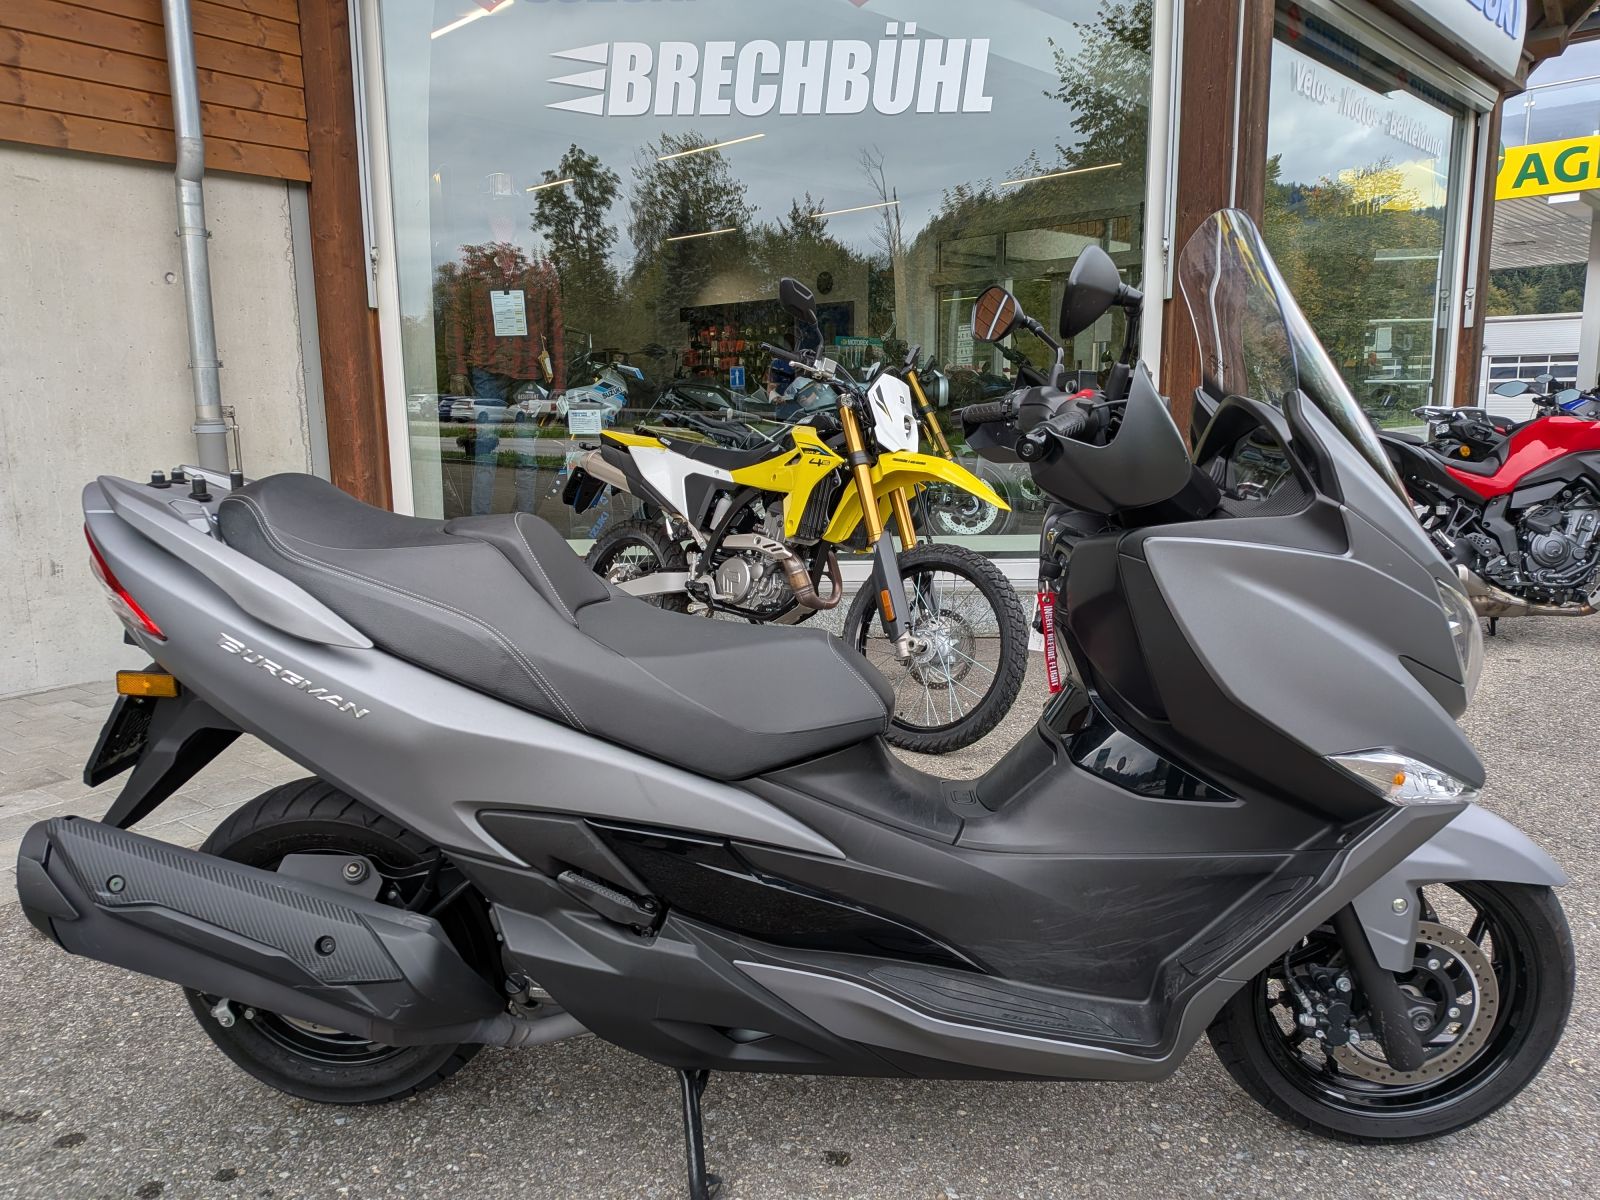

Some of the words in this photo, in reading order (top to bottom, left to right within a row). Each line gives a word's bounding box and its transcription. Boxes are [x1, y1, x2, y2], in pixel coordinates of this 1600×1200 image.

[607, 22, 994, 117] BRECHBÜHL
[1296, 60, 1330, 103] Velos
[1343, 86, 1379, 128] Motos
[1389, 110, 1443, 159] Bekleidung
[1043, 605, 1055, 632] INSERT
[1046, 633, 1056, 661] BEFORE
[215, 632, 371, 719] BURGMAN
[1048, 661, 1059, 687] FLIGHT
